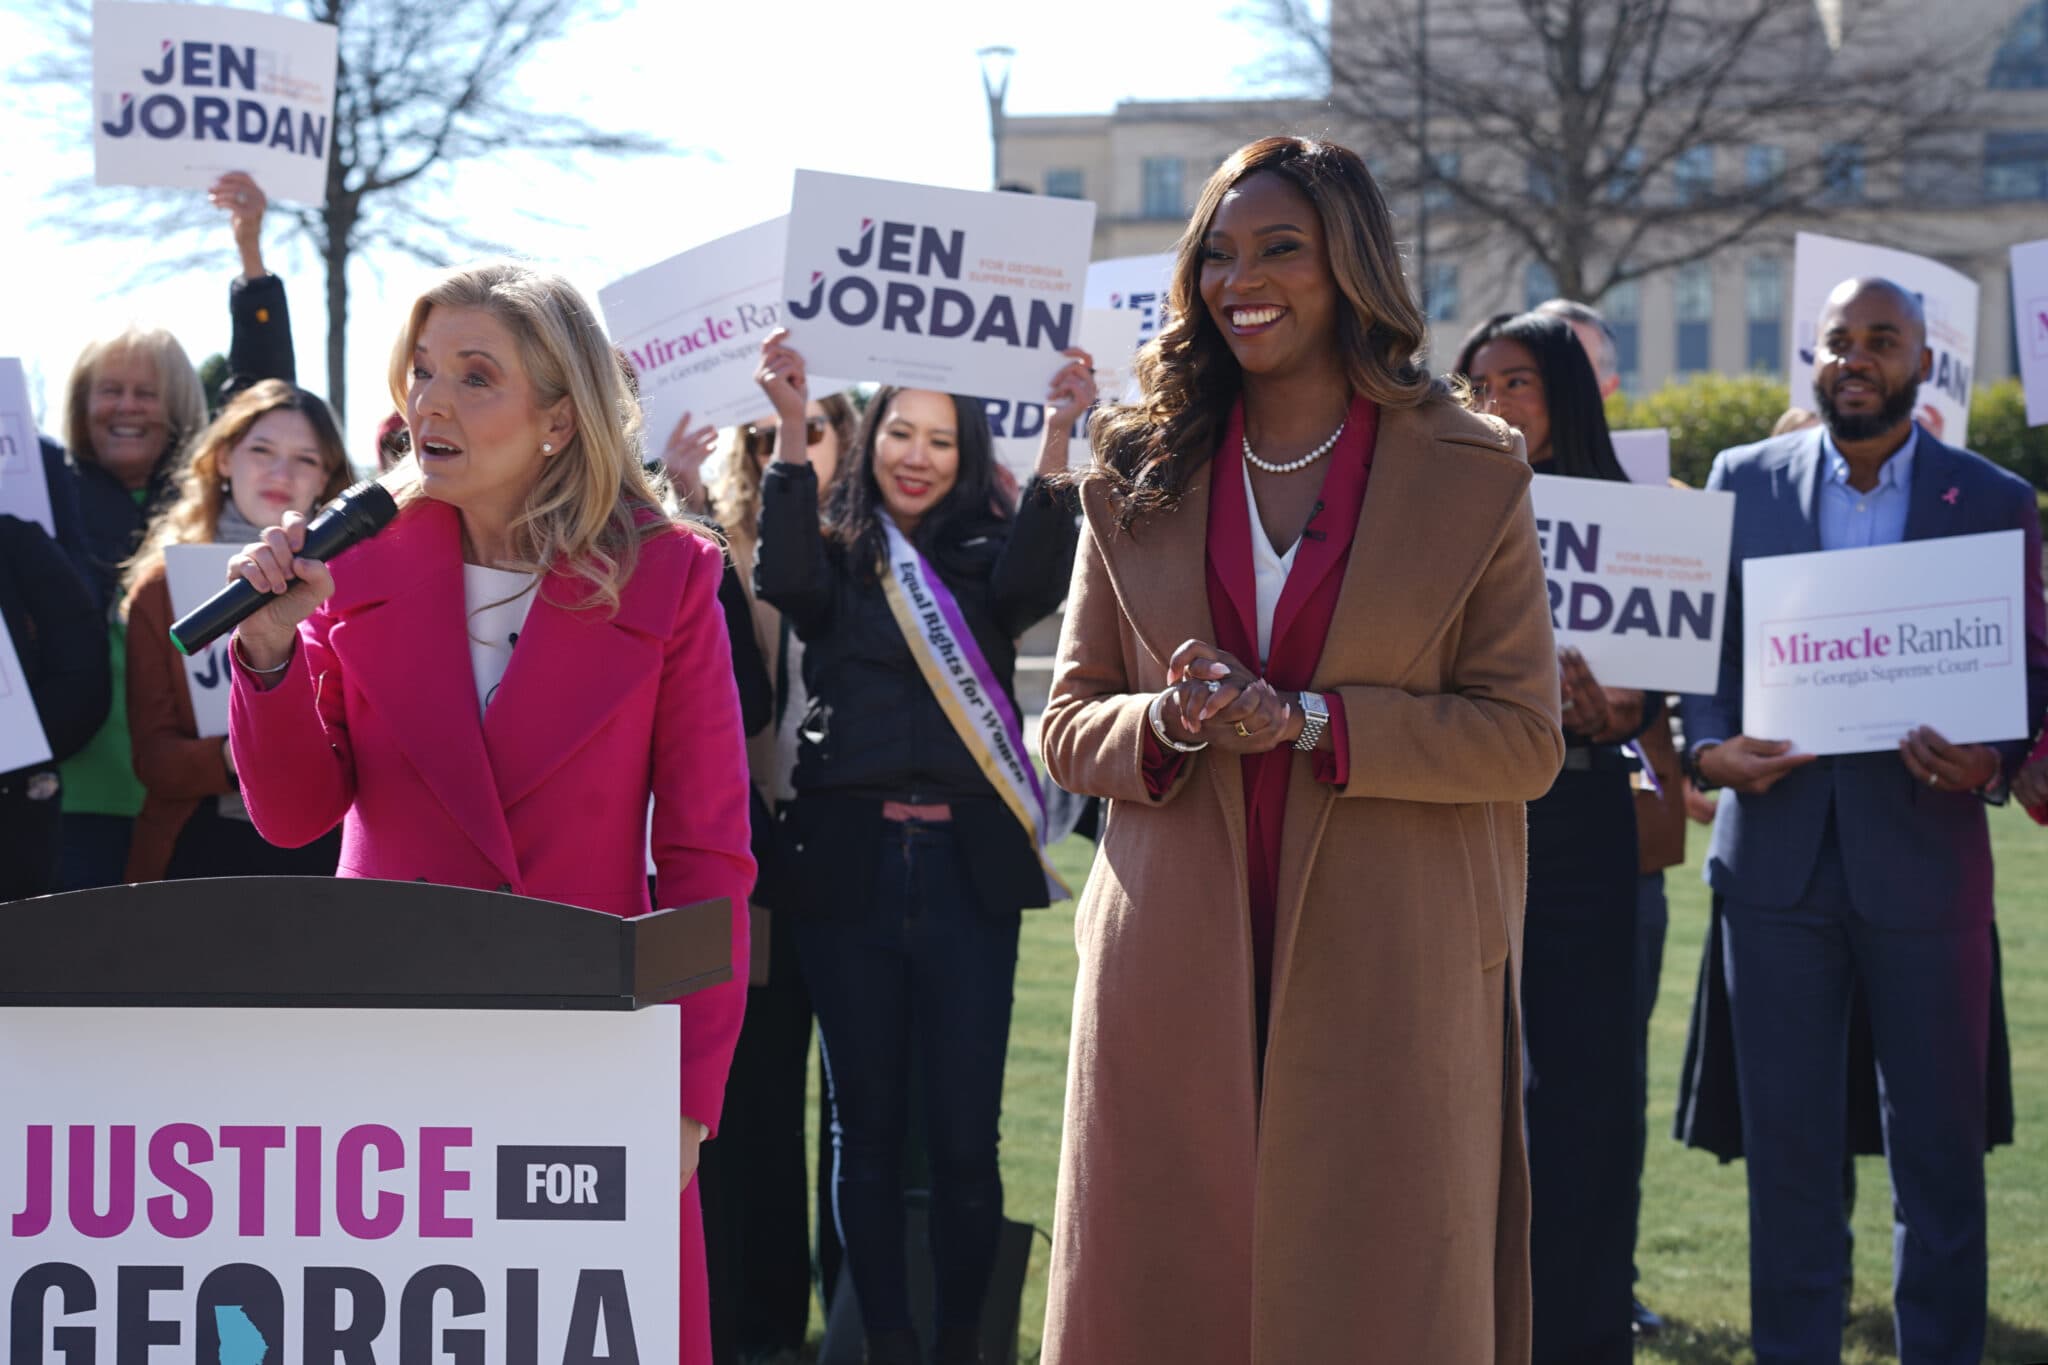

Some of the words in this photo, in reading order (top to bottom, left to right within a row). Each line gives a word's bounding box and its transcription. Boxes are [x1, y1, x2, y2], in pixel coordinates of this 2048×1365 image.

[141, 39, 256, 91] JEN
[102, 92, 326, 159] JORDAN
[837, 217, 965, 280] JEN
[630, 317, 734, 373] Miracle
[737, 302, 781, 333] Ra
[787, 271, 1073, 351] JORDAN
[899, 562, 933, 611] Equal
[922, 610, 964, 676] Rights
[957, 677, 985, 708] for
[981, 710, 1026, 784] Women
[1768, 627, 1891, 668] Miracle
[1897, 616, 2003, 656] Rankin
[1813, 666, 1869, 688] Georgia
[1870, 660, 1935, 684] Supreme
[1936, 657, 1979, 676] Court
[12, 1122, 474, 1240] JUSTICE
[526, 1163, 598, 1204] FOR
[10, 1261, 642, 1365] GEORGIA
